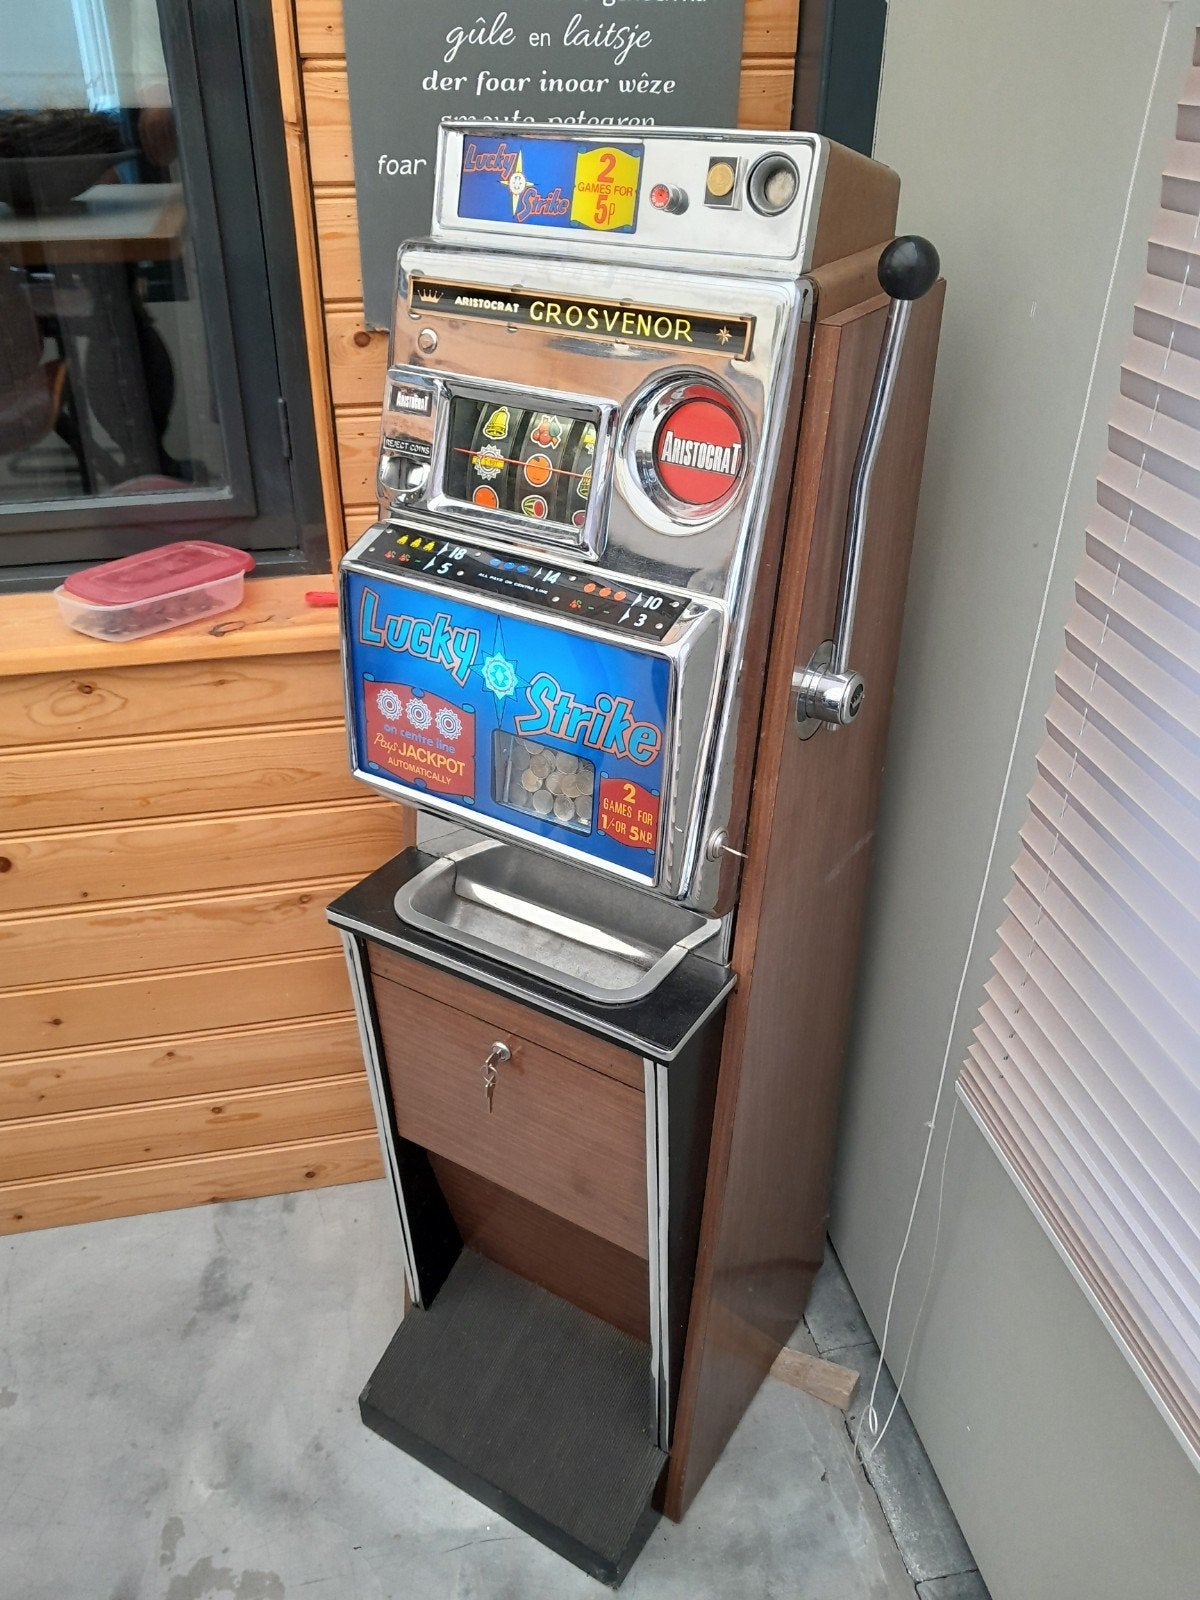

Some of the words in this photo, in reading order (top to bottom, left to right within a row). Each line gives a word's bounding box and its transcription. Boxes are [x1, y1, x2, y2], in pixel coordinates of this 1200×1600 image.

[444, 11, 517, 63] gûle
[528, 26, 551, 47] en
[563, 13, 652, 65] laitsje
[421, 69, 467, 92] der
[475, 70, 531, 95] foar
[539, 70, 609, 93] inoar
[618, 73, 677, 95] wêze
[377, 154, 427, 176] foar
[464, 143, 518, 180] Lucky
[597, 153, 617, 184] 2
[577, 181, 611, 196] GAMES
[614, 185, 634, 197] FOR
[516, 187, 571, 223] Strike
[454, 296, 520, 313] ARISTOCRAT
[529, 301, 693, 342] GROSVENOR
[385, 439, 408, 450] REJECT
[409, 444, 431, 455] COINS
[660, 430, 742, 475] ARISTOCRAT
[448, 547, 467, 561] 18
[437, 563, 452, 575] 5
[542, 570, 561, 584] 14
[642, 595, 663, 610] 10
[633, 613, 648, 627] 3
[359, 586, 480, 687] Lucky
[514, 672, 662, 766] Strike
[383, 723, 397, 734] on
[400, 729, 434, 747] centre
[435, 738, 456, 754] line
[373, 732, 399, 754] Pays
[398, 742, 466, 776] JACKPOT
[387, 756, 452, 785] AUTOMATICALLY
[622, 783, 636, 804] 2
[603, 797, 633, 818] GAMES
[637, 809, 653, 826] FOR
